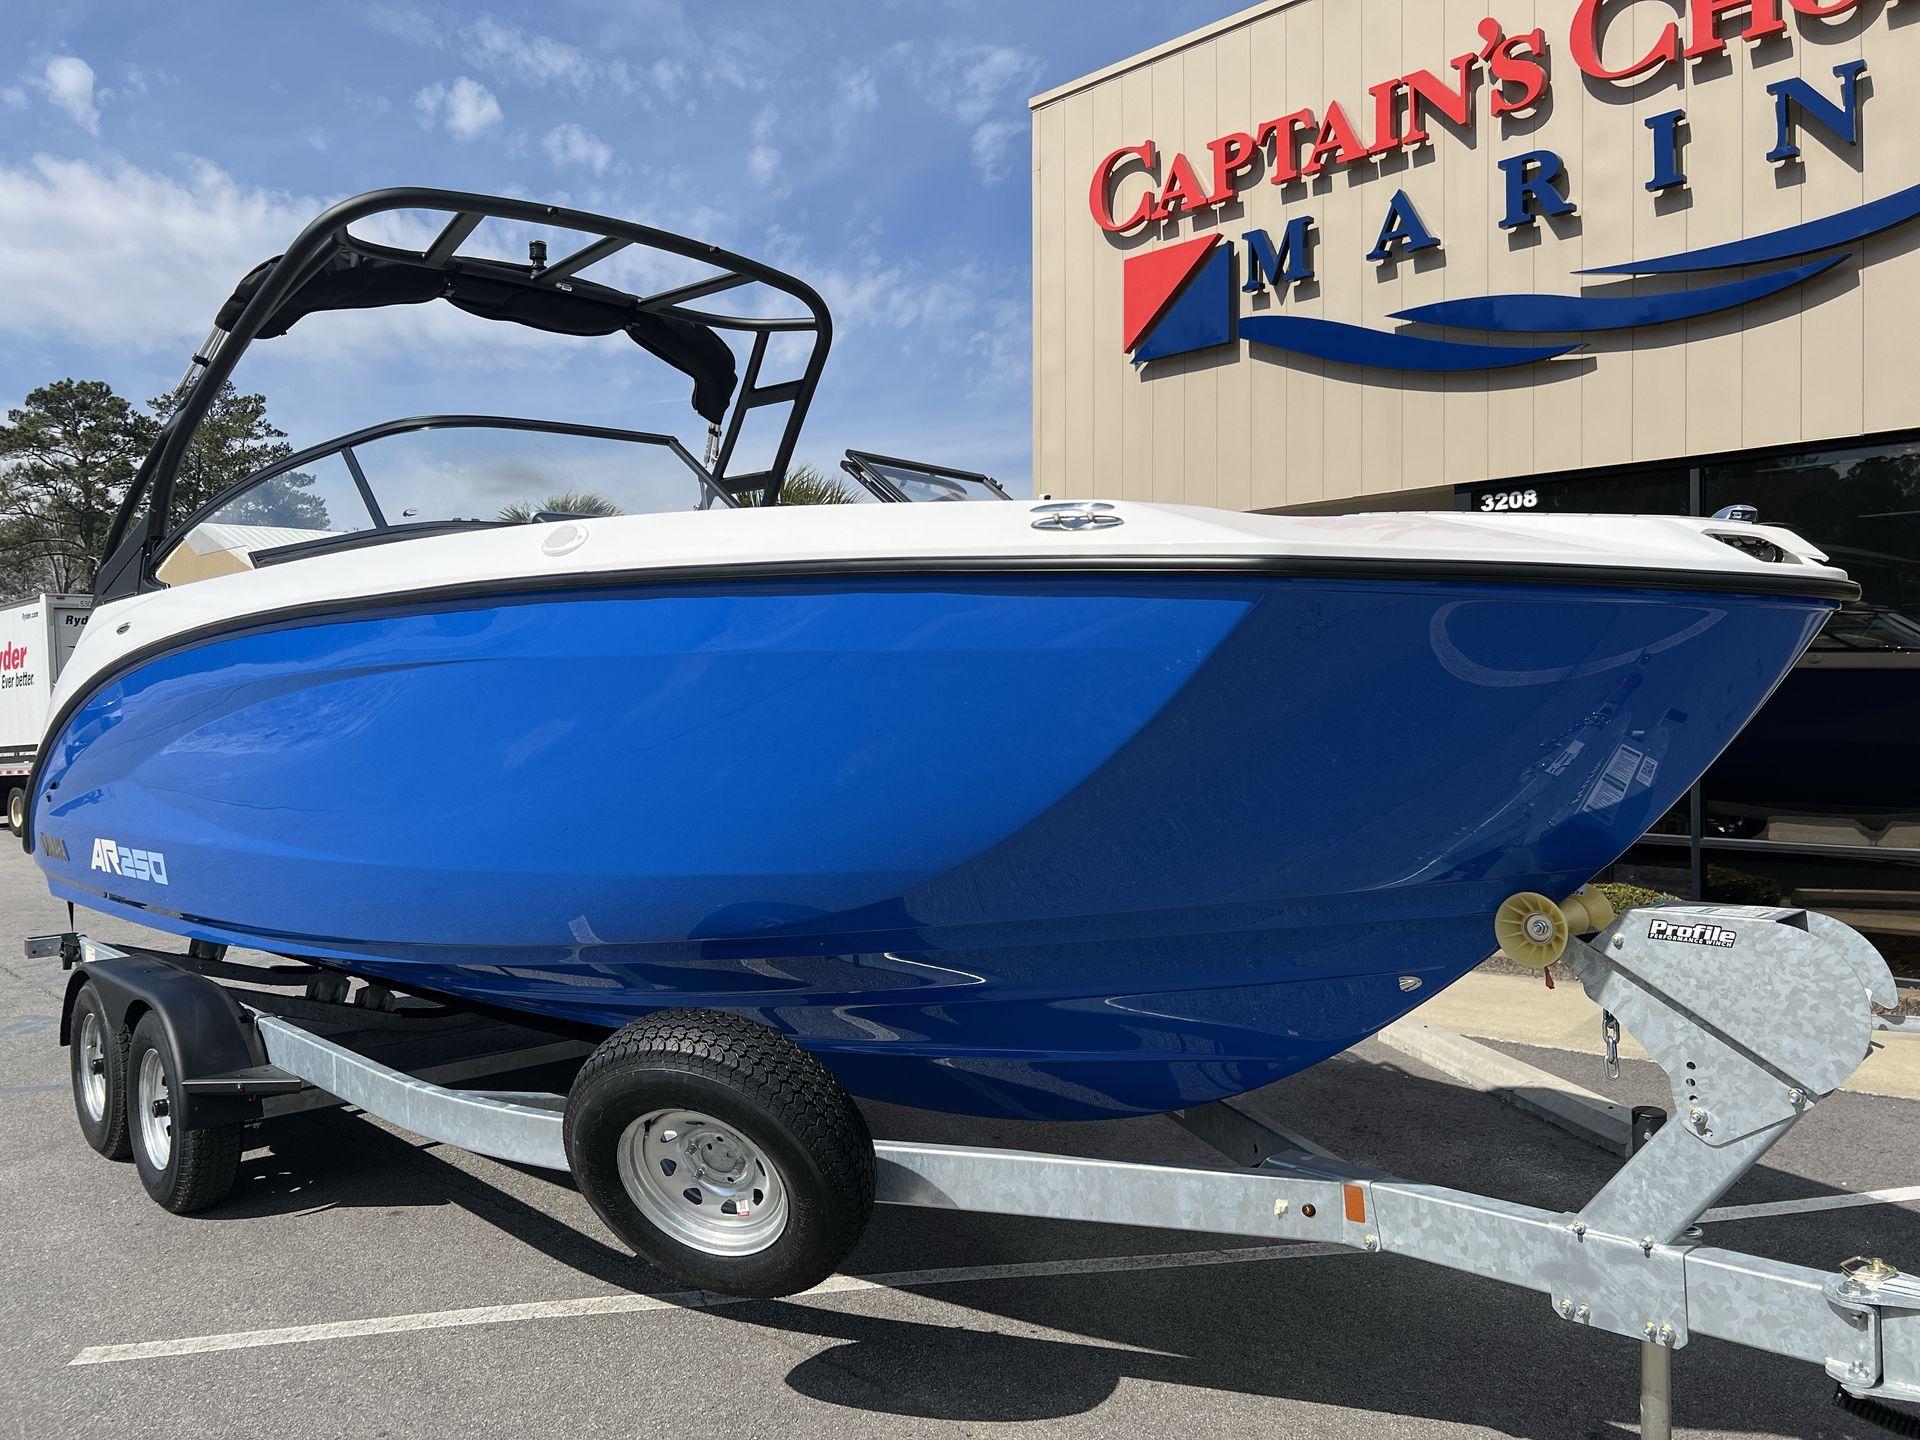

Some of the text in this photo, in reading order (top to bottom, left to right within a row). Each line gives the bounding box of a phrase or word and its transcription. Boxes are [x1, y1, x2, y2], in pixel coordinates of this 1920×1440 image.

[1089, 0, 1860, 232] CAPTAIN'S CH
[1241, 59, 1867, 294] MARIN
[1480, 489, 1538, 512] 3208
[2, 674, 14, 689] Ever
[91, 838, 167, 885] AR250
[1649, 933, 1732, 948] PERFORMANCE WINCH
[1650, 920, 1736, 943] Profile
